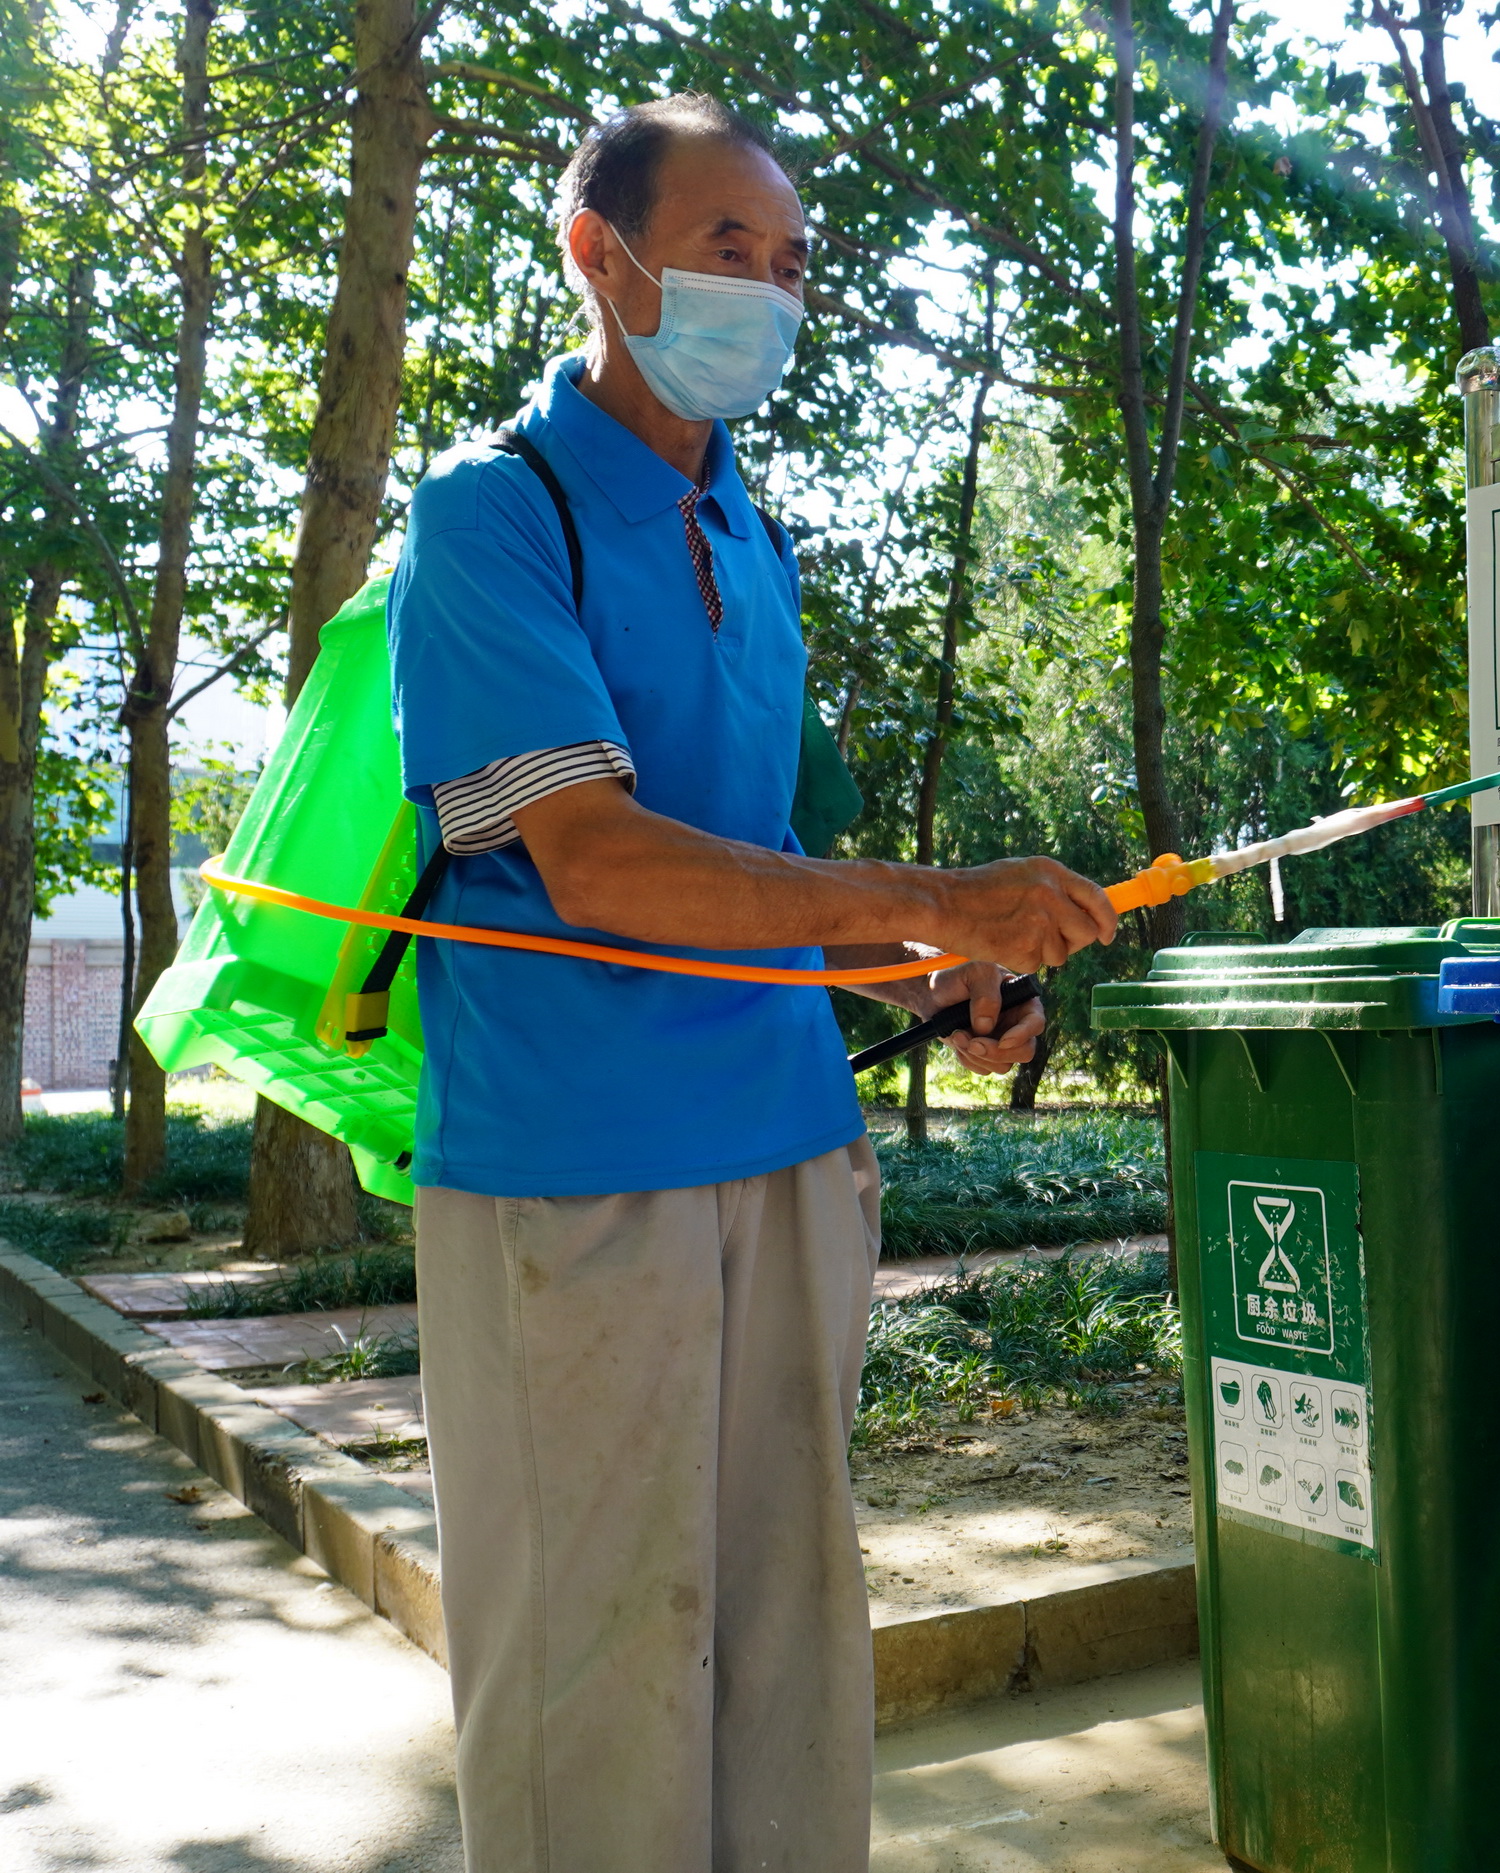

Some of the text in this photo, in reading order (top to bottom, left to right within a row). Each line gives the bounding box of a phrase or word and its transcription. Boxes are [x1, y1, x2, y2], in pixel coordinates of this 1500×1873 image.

[1247, 1294, 1318, 1326] 厨余垃圾
[1256, 1324, 1308, 1342] FOOD WASTE
